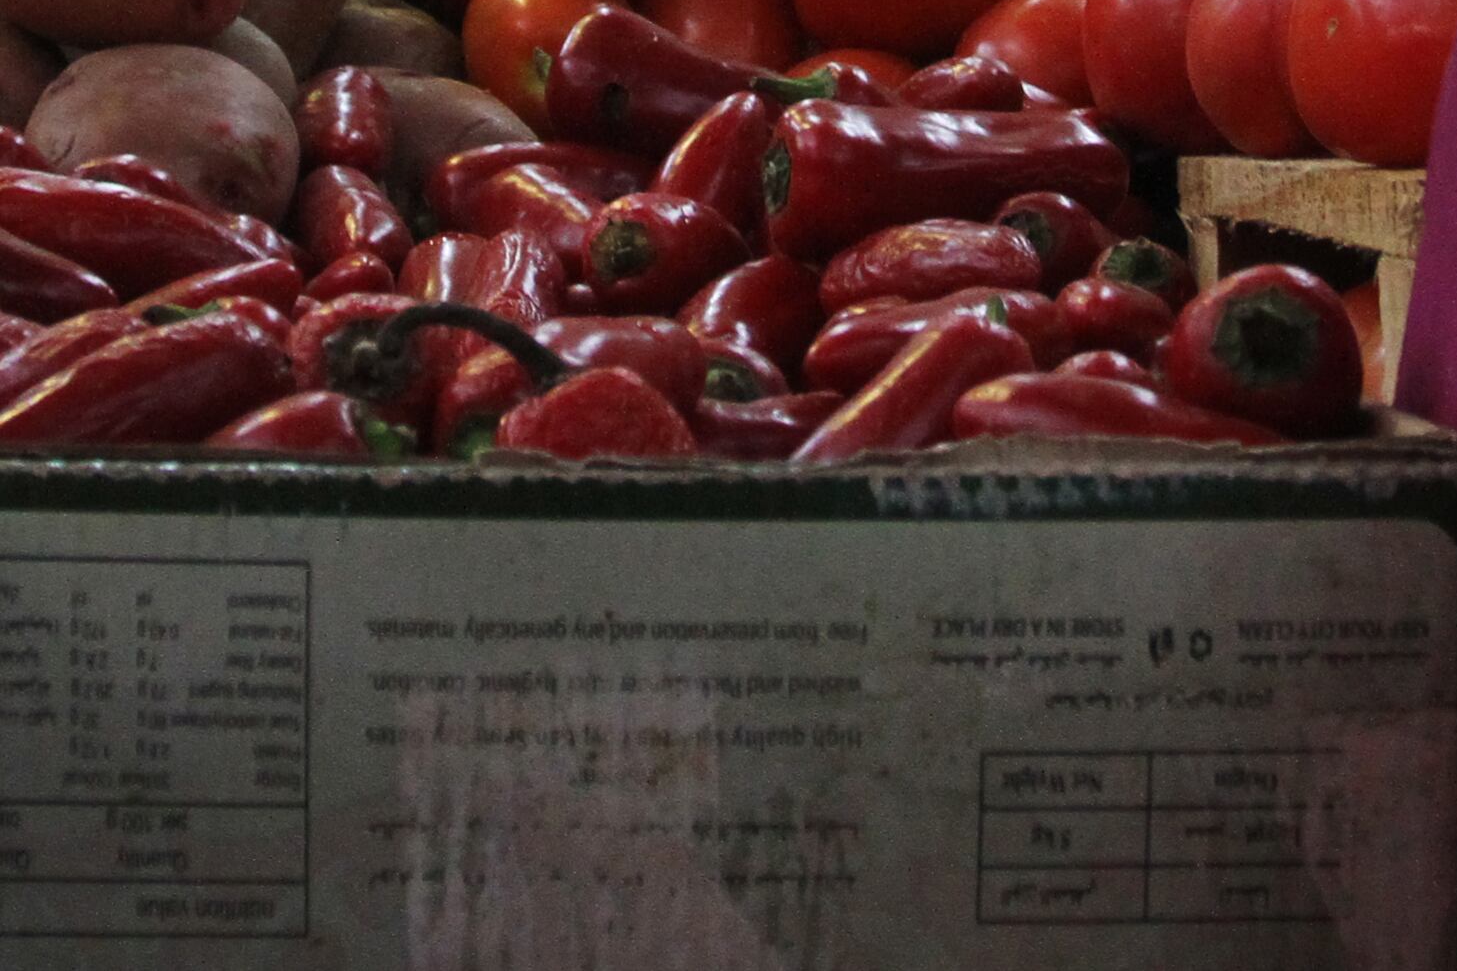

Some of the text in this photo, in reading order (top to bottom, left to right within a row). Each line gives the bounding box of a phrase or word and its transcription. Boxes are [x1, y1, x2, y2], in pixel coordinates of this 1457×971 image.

[464, 614, 567, 646] genetically
[574, 614, 605, 639] any
[609, 622, 647, 645] and
[650, 618, 769, 641] preservation
[774, 623, 818, 646] from
[827, 622, 868, 646] Free
[990, 617, 1027, 639] DRY
[1030, 618, 1044, 639] A
[1046, 618, 1067, 639] IN
[1072, 617, 1125, 639] STORE
[747, 677, 783, 699] and
[789, 677, 861, 700] washed
[732, 723, 805, 755] quality
[812, 723, 862, 751] High
[1072, 771, 1103, 795] Net
[136, 899, 189, 923] value
